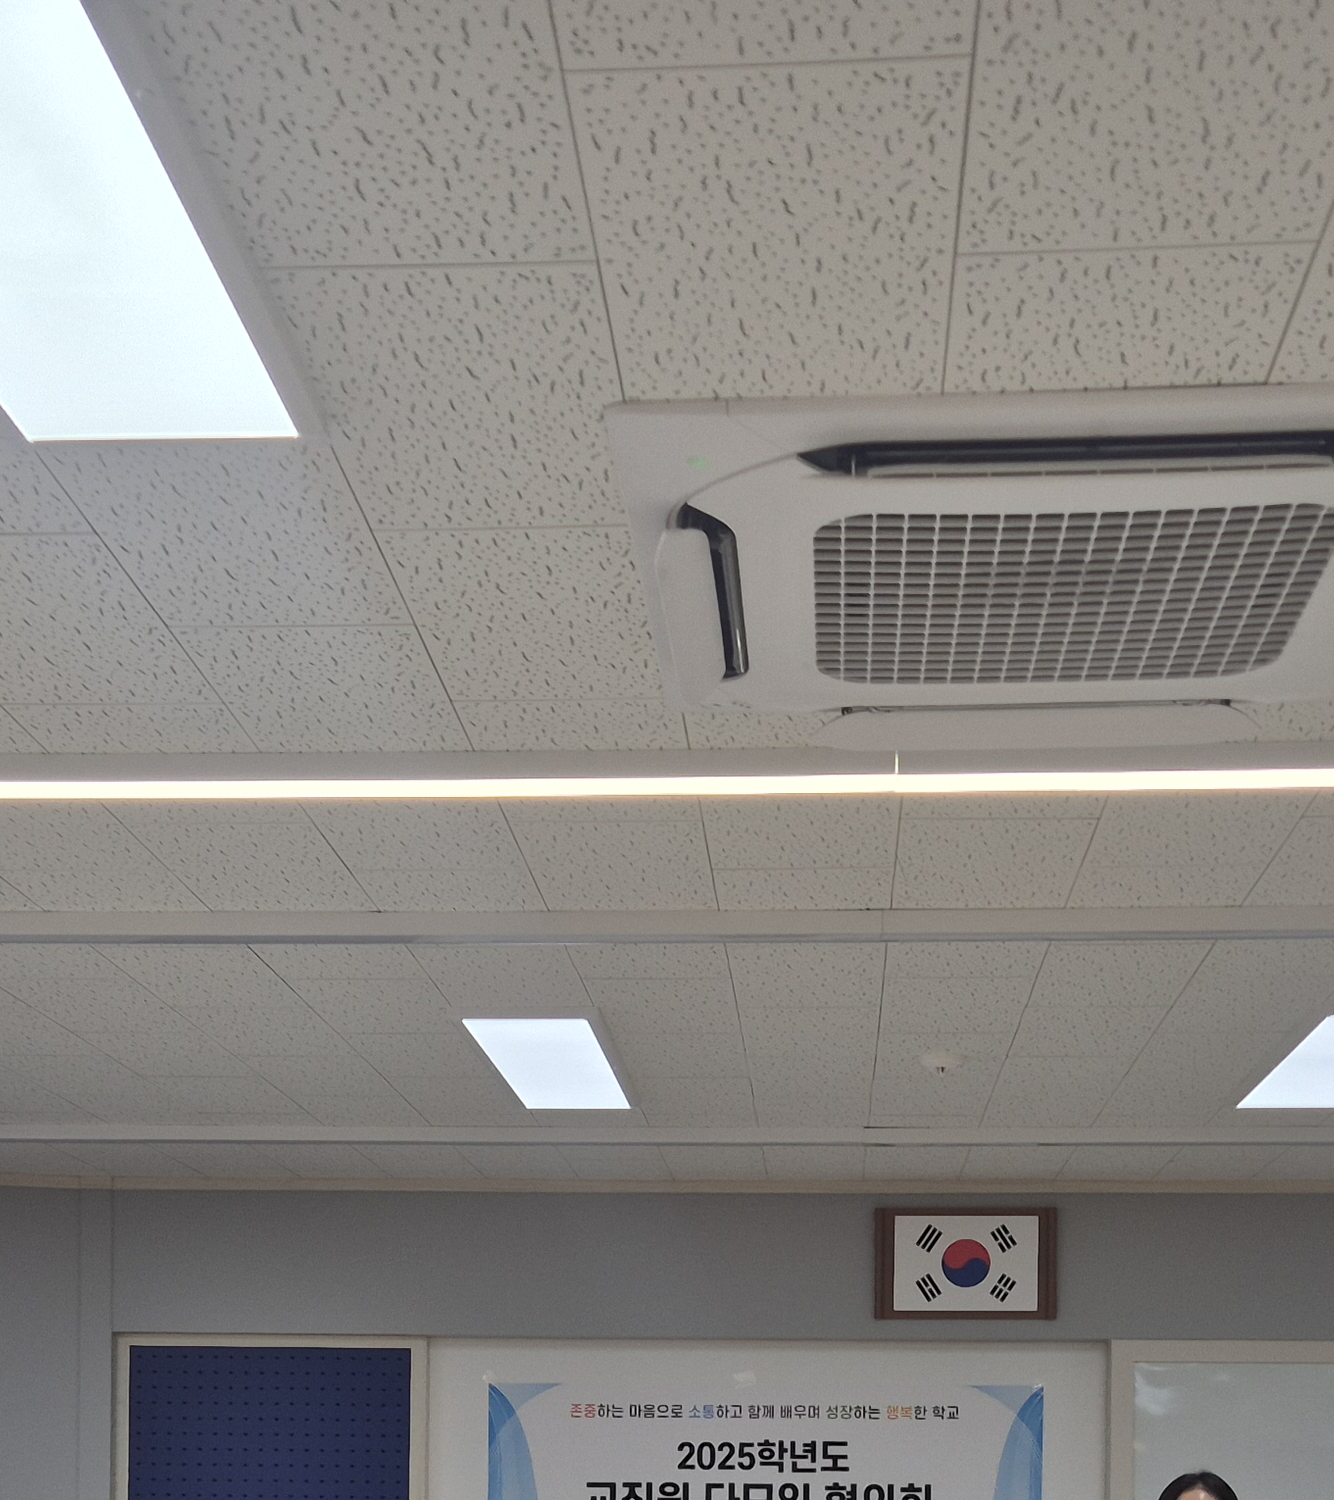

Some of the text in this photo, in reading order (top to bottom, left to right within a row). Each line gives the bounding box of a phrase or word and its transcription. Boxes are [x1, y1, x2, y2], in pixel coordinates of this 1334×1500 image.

[570, 1403, 960, 1420] 존중하는 마음으로 소통하고 함께 배우며 성장하는 행복한 학교
[677, 1439, 850, 1473] 2025학년도
